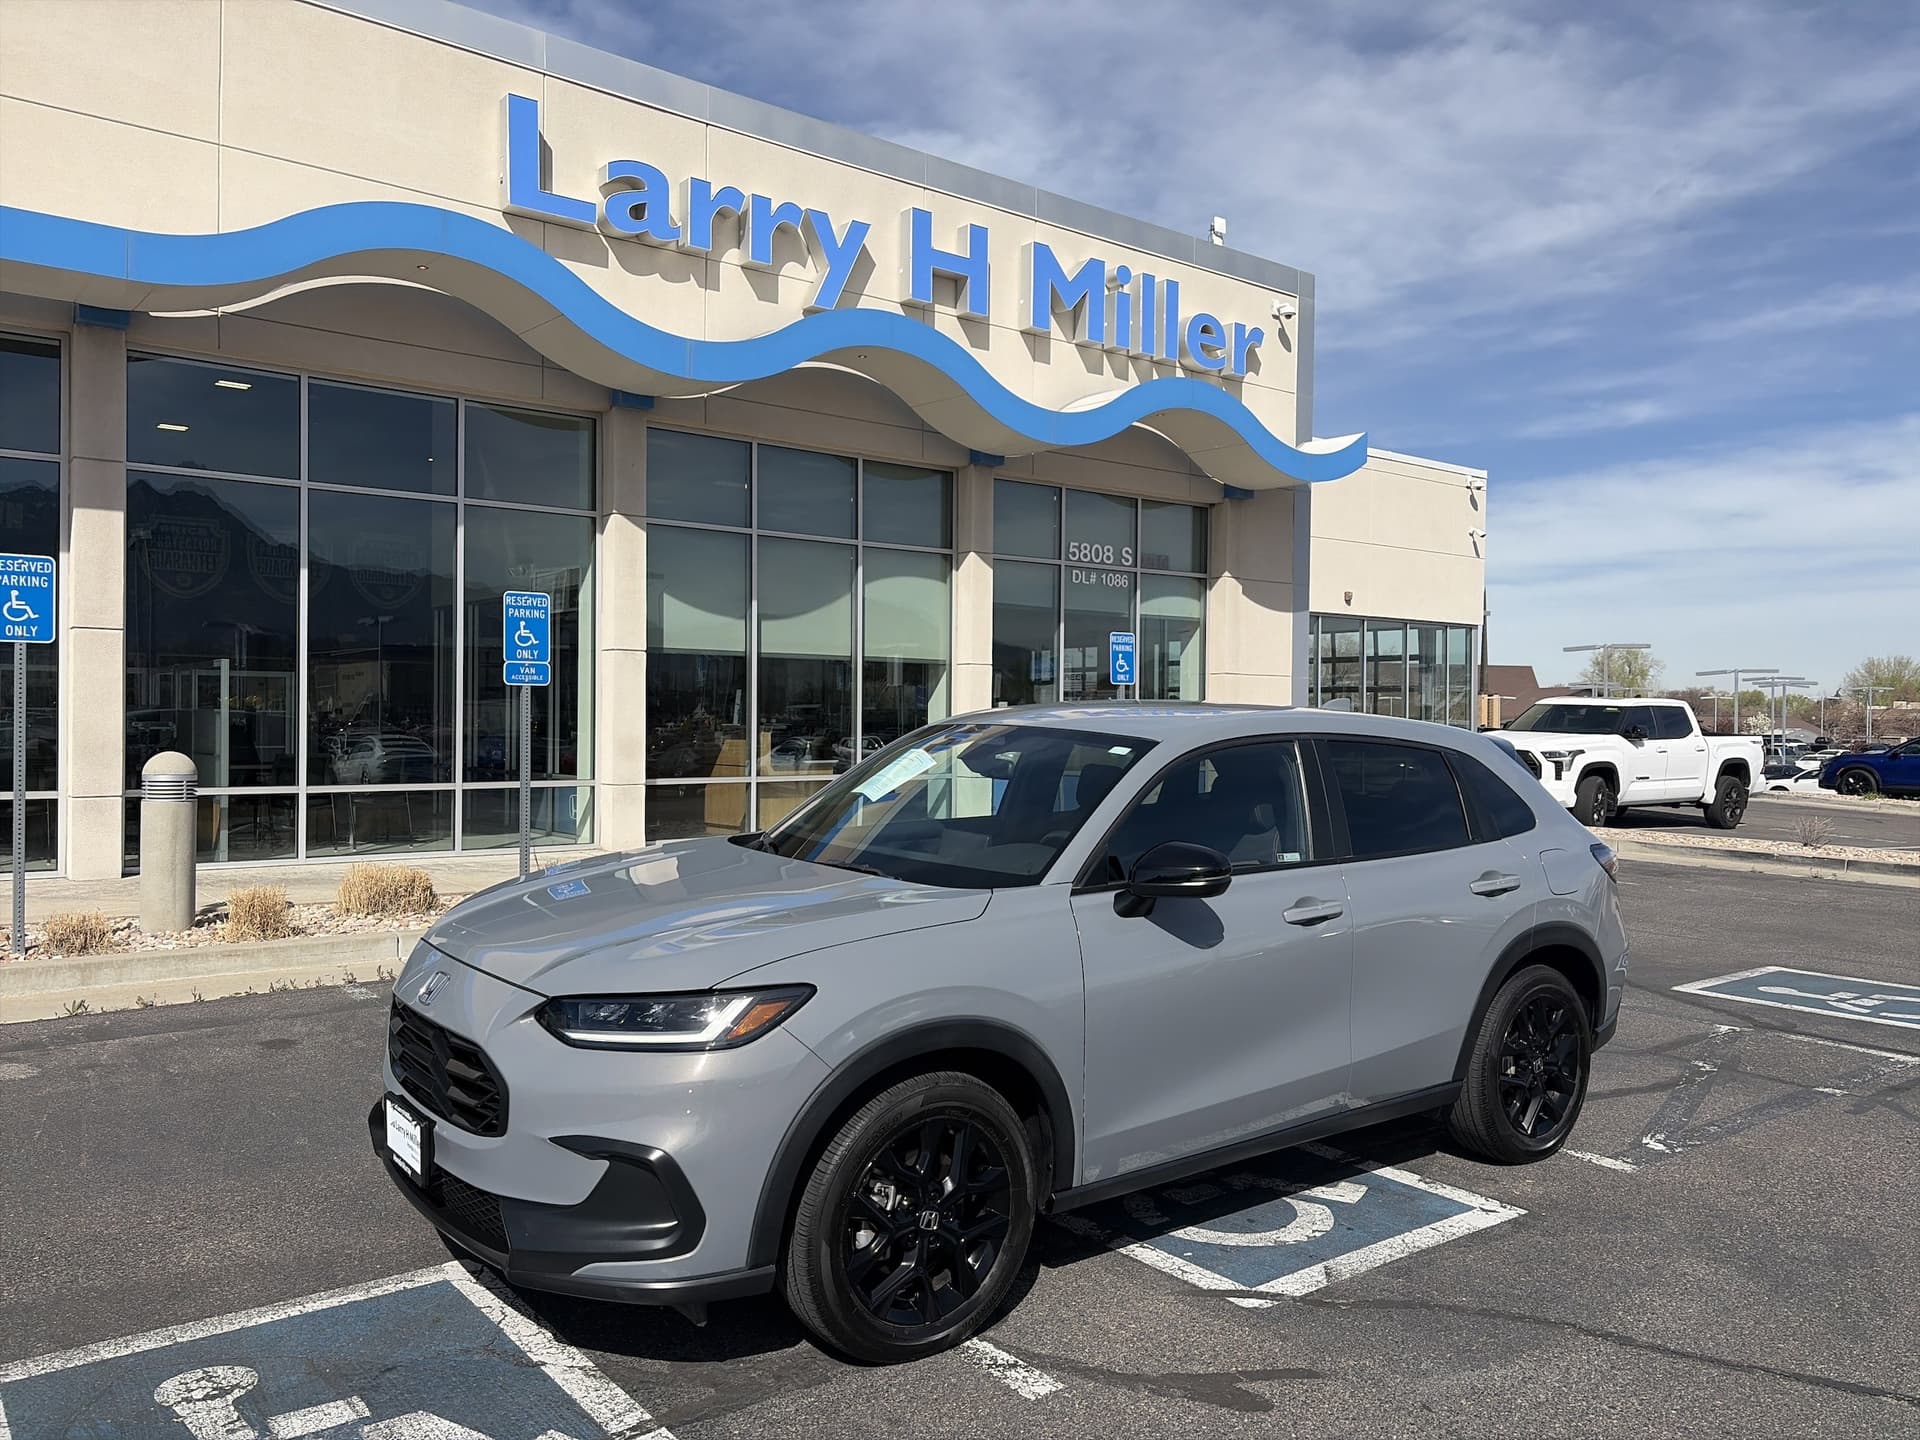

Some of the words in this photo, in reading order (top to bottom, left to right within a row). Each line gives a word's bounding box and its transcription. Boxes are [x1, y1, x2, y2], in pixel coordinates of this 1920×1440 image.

[505, 93, 870, 310] Larry
[905, 207, 990, 316] H
[1028, 241, 1265, 376] Miller
[1068, 542, 1114, 564] 5808
[1121, 546, 1133, 566] S
[0, 559, 52, 573] ESERVED
[0, 574, 49, 588] ARKING
[1072, 569, 1097, 585] DL#
[1101, 573, 1129, 588] 1086
[506, 596, 547, 607] RESERVED
[508, 607, 545, 619] PARKING
[5, 624, 39, 637] ONLY
[516, 649, 539, 659] ONLY
[519, 666, 536, 674] VAN
[511, 673, 544, 681] ACCESSIBLE
